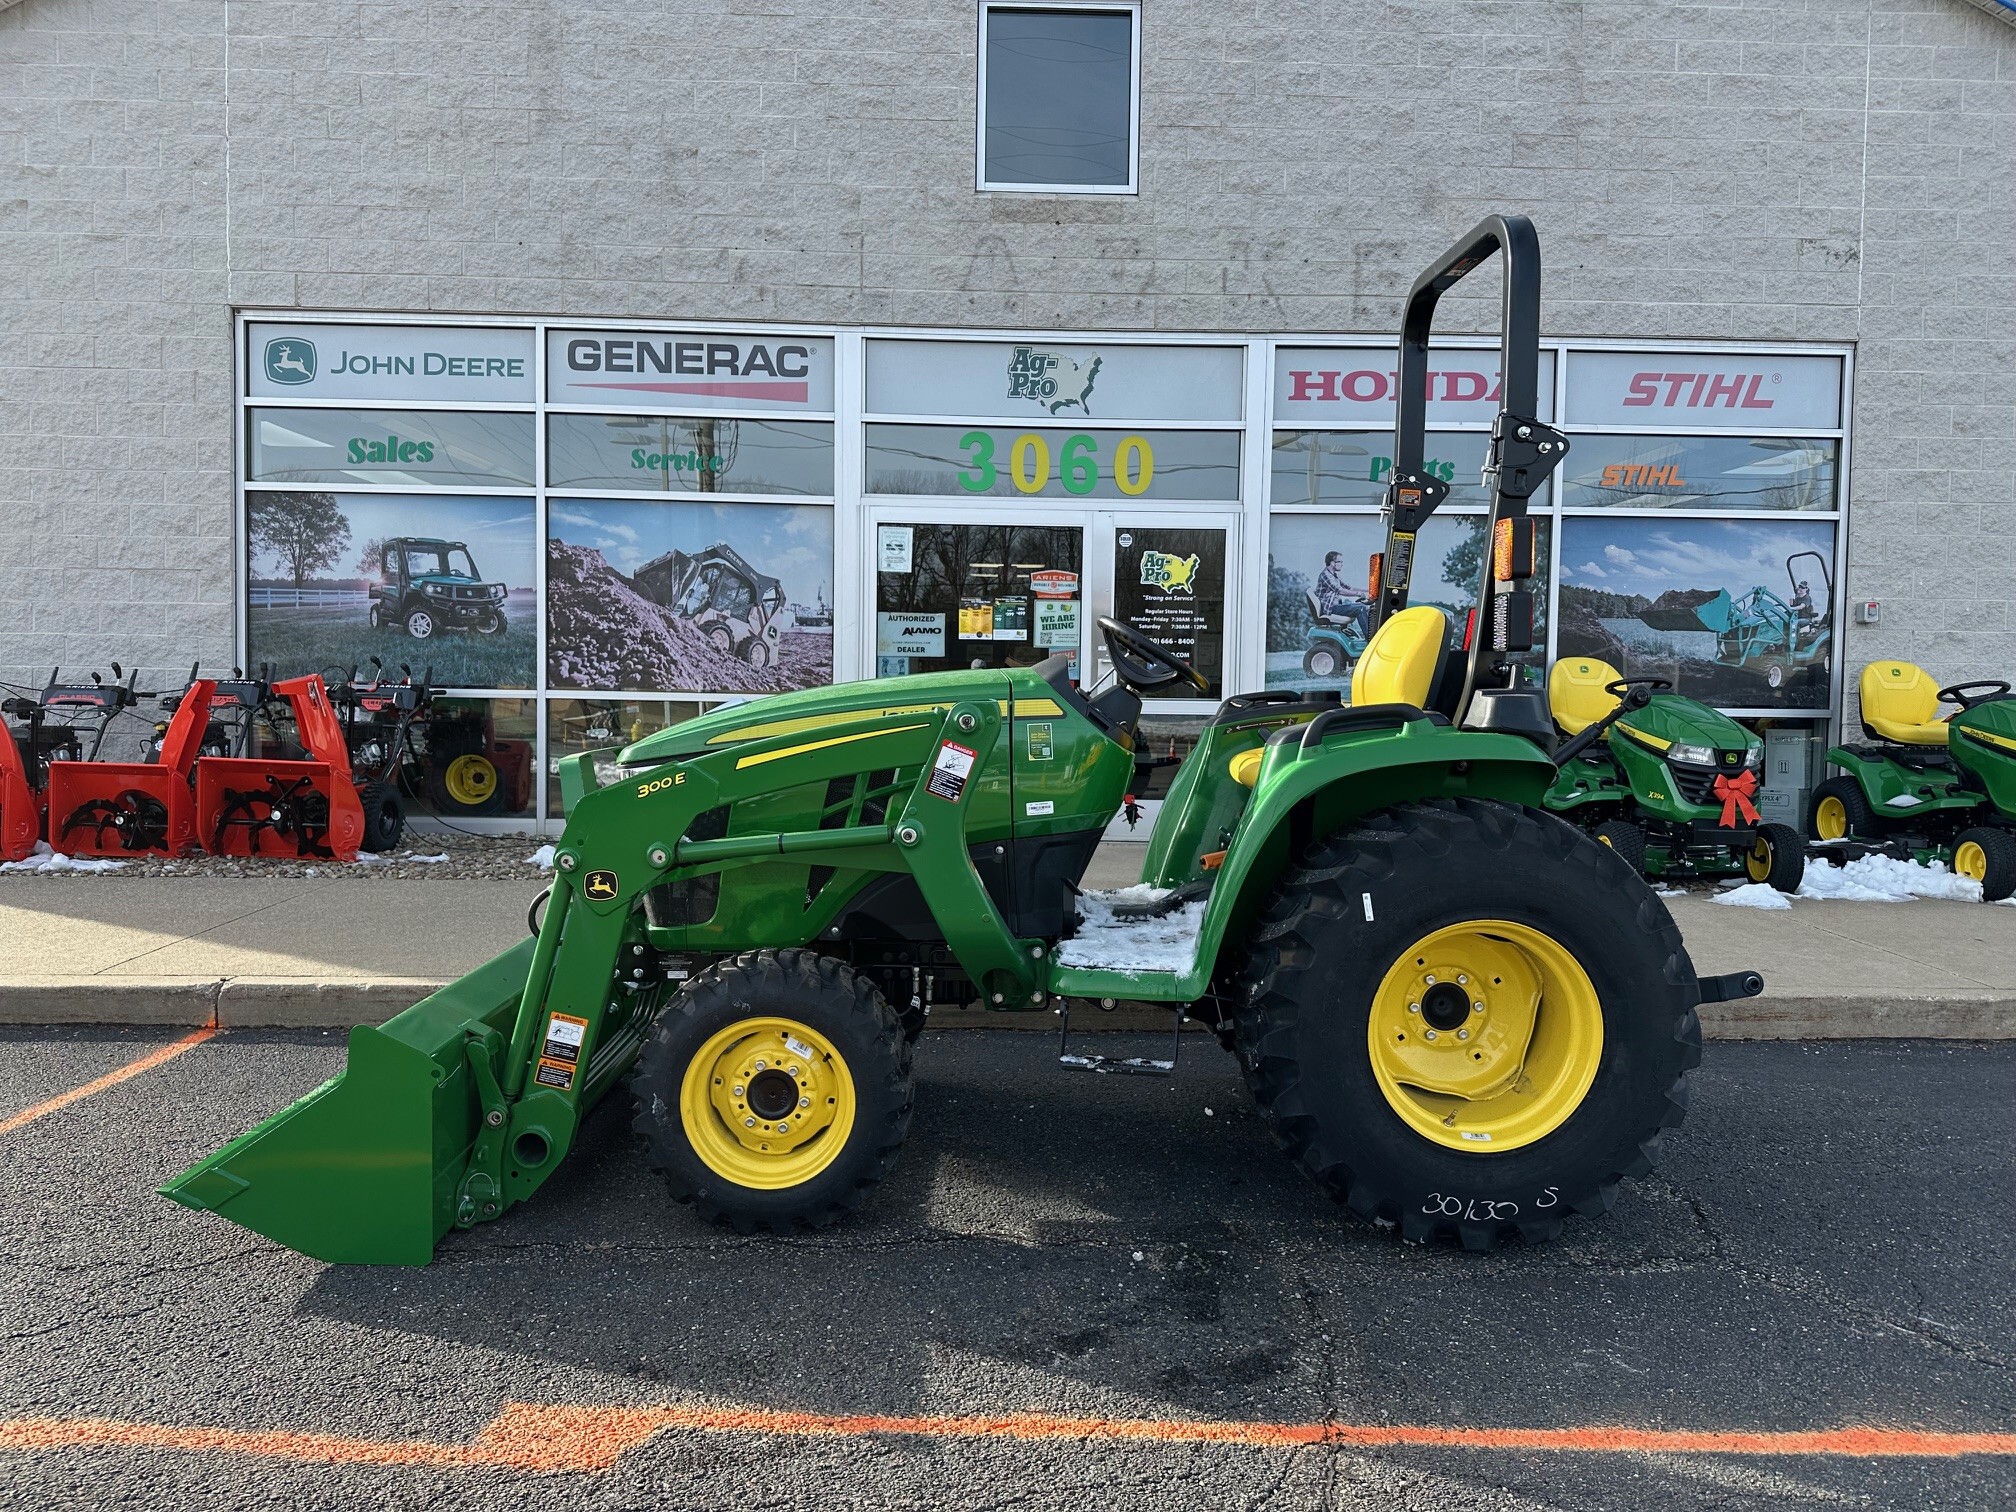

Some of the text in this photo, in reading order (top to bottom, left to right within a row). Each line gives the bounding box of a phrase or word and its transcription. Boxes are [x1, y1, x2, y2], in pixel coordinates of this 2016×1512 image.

[331, 351, 524, 377] JOHN DEERE
[568, 339, 809, 378] GENERAC
[1008, 373, 1058, 398] Pro
[1622, 372, 1775, 409] STIHL
[347, 435, 435, 464] Sales
[631, 448, 724, 474] Service
[958, 431, 1154, 496] 3060
[1369, 456, 1456, 483] Pts
[1600, 464, 1687, 487] STIHL
[1144, 568, 1171, 582] Pro
[1040, 614, 1075, 623] WE ARE
[1041, 622, 1074, 630] HIRING
[902, 627, 942, 636] ALAMO
[560, 1015, 584, 1025] WARNING
[549, 1062, 572, 1071] WARNING
